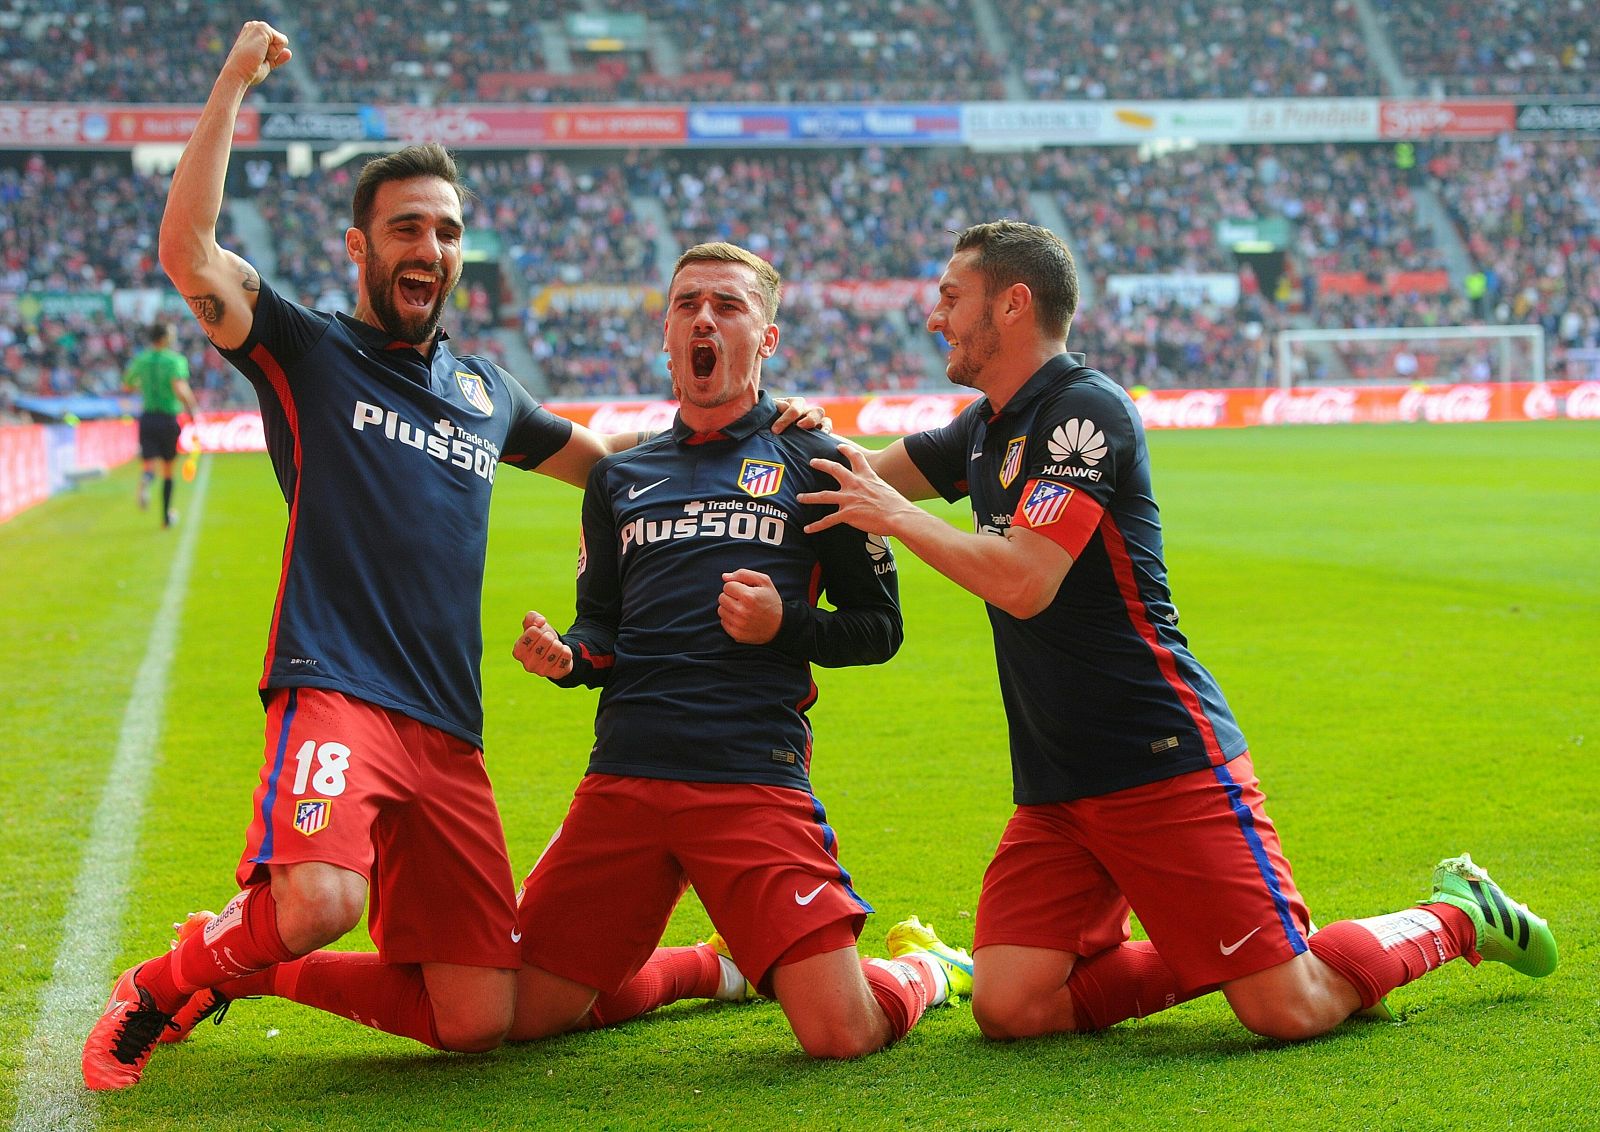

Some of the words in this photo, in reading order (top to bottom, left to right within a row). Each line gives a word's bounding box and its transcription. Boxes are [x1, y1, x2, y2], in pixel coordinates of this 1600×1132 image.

[353, 401, 498, 485] Plus500
[456, 426, 483, 447] Trade
[1041, 464, 1103, 482] HUAWEI
[707, 500, 743, 511] Trade
[746, 501, 788, 521] Online
[621, 512, 785, 555] Plus500
[292, 740, 351, 797] 18
